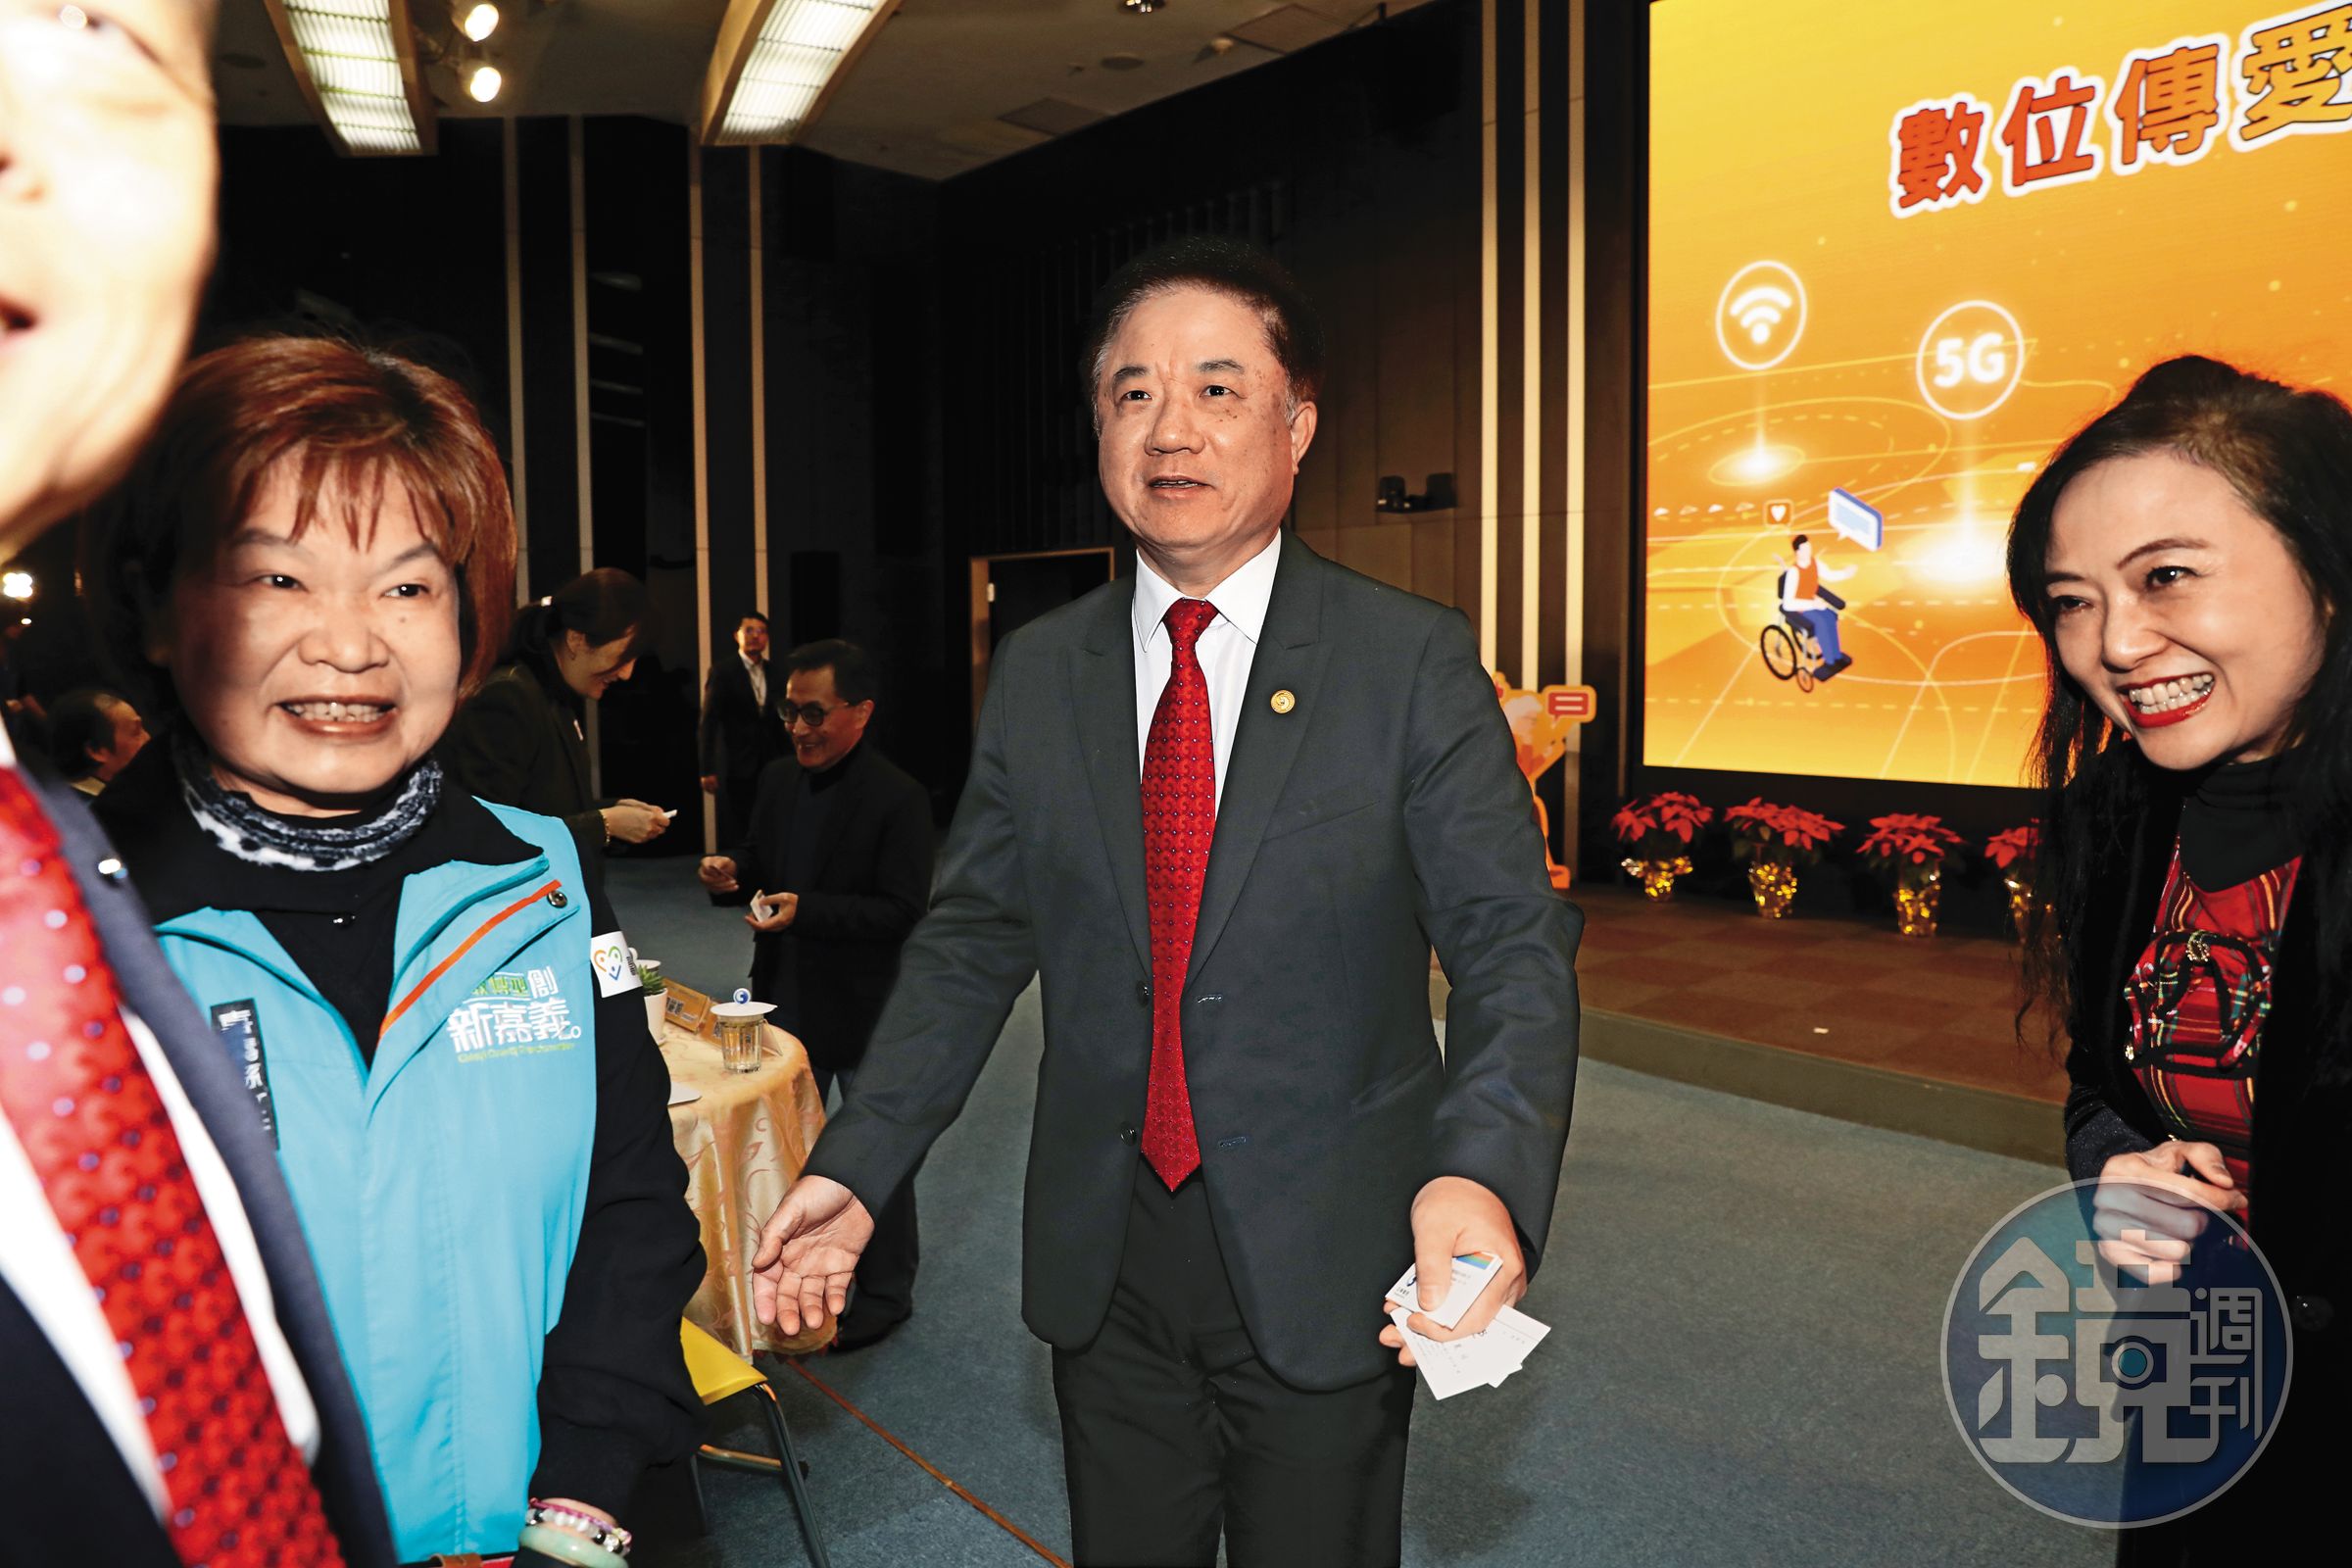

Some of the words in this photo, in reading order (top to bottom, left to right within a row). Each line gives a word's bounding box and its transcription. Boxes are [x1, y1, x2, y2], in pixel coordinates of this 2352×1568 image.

[1895, 1, 2352, 210] 數位傳愛
[1934, 332, 2005, 387] 5G
